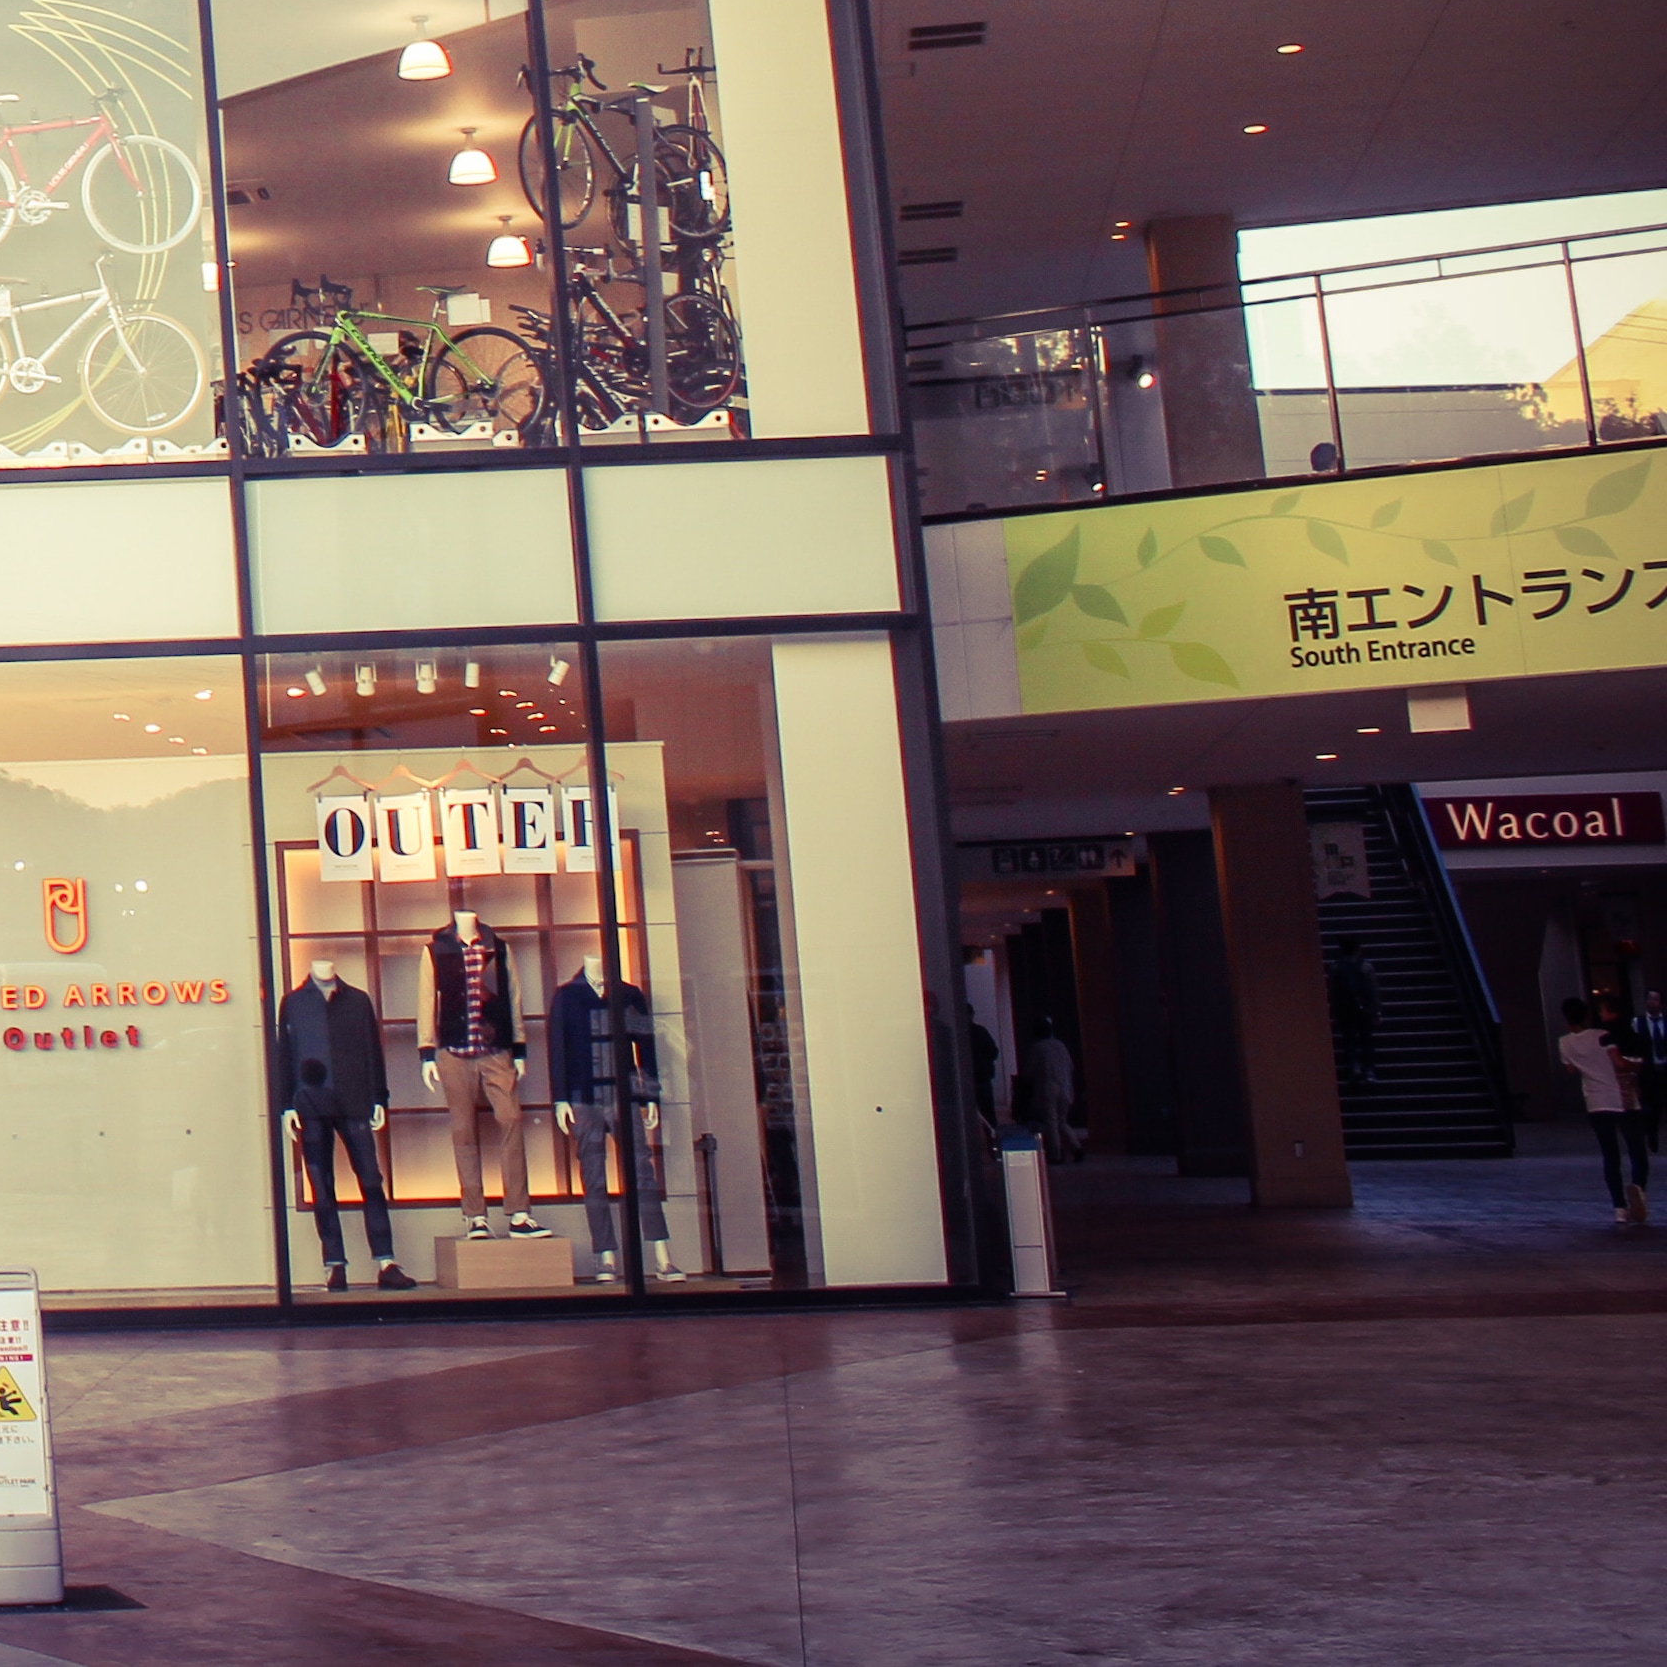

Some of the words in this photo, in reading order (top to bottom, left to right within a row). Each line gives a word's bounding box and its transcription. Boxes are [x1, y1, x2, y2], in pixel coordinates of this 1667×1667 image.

[1291, 642, 1361, 669] South
[1367, 636, 1476, 663] Entrance
[1445, 797, 1624, 841] Wacoal
[63, 979, 230, 1008] ARROWS
[3, 1024, 142, 1051] Outlet
